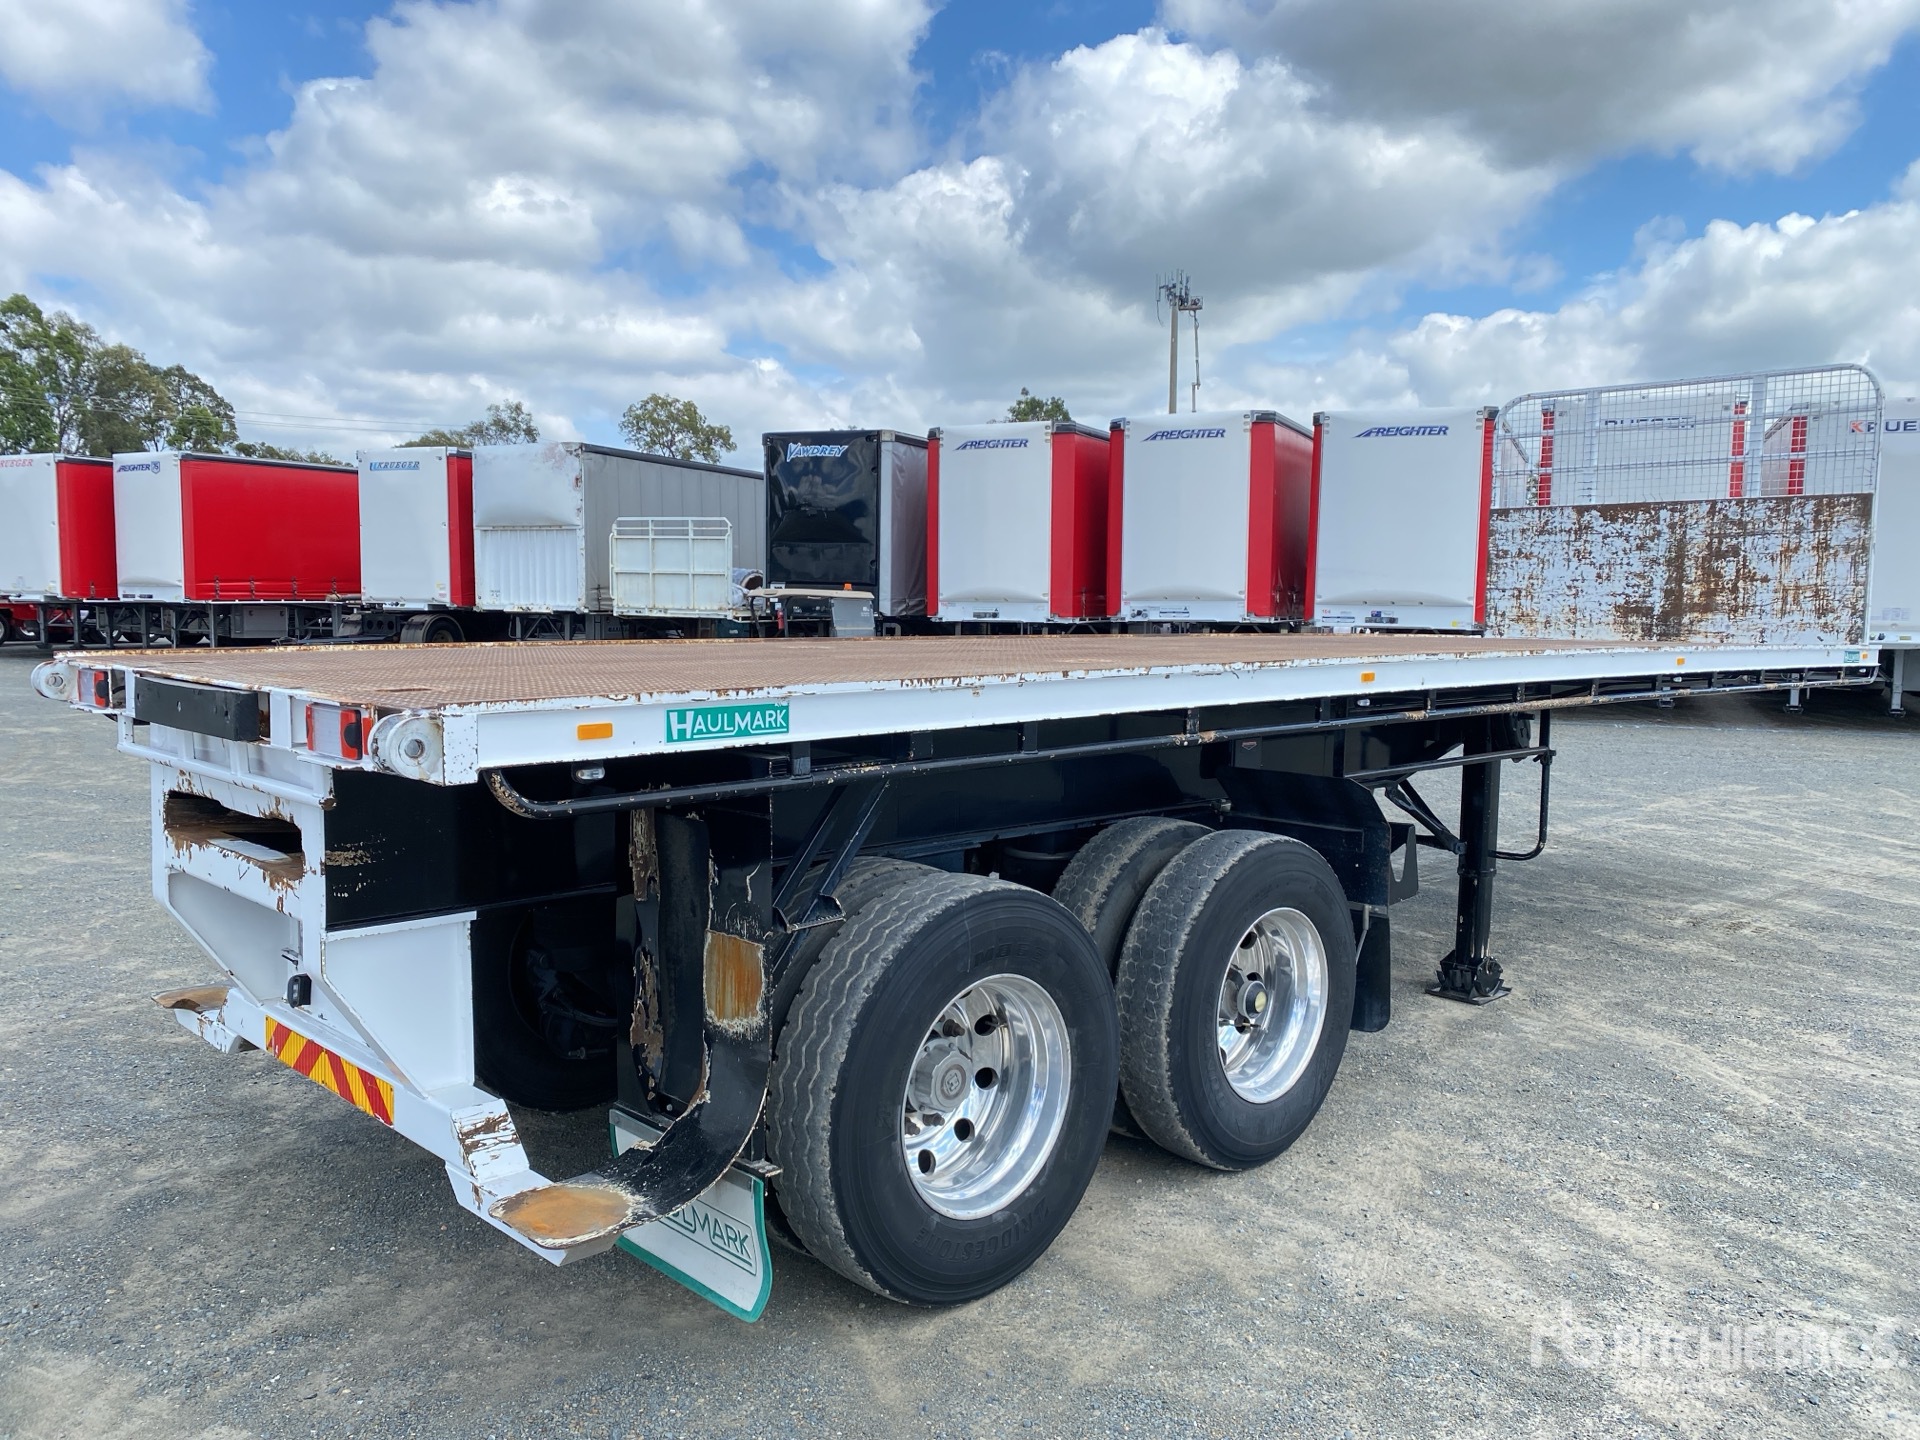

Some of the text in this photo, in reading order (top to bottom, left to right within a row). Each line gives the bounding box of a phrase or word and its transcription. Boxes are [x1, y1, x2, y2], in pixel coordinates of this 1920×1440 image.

[1141, 428, 1226, 441] FREIGHTER
[1352, 425, 1449, 438] FREIGHTER
[954, 438, 1029, 450] FREIGHTER
[786, 443, 848, 462] VAWDREY
[117, 463, 150, 472] FREIGHTER
[375, 461, 420, 470] KRUEGER
[668, 709, 788, 741] HAULMARK
[912, 1197, 1049, 1264] BRIDGESTONE
